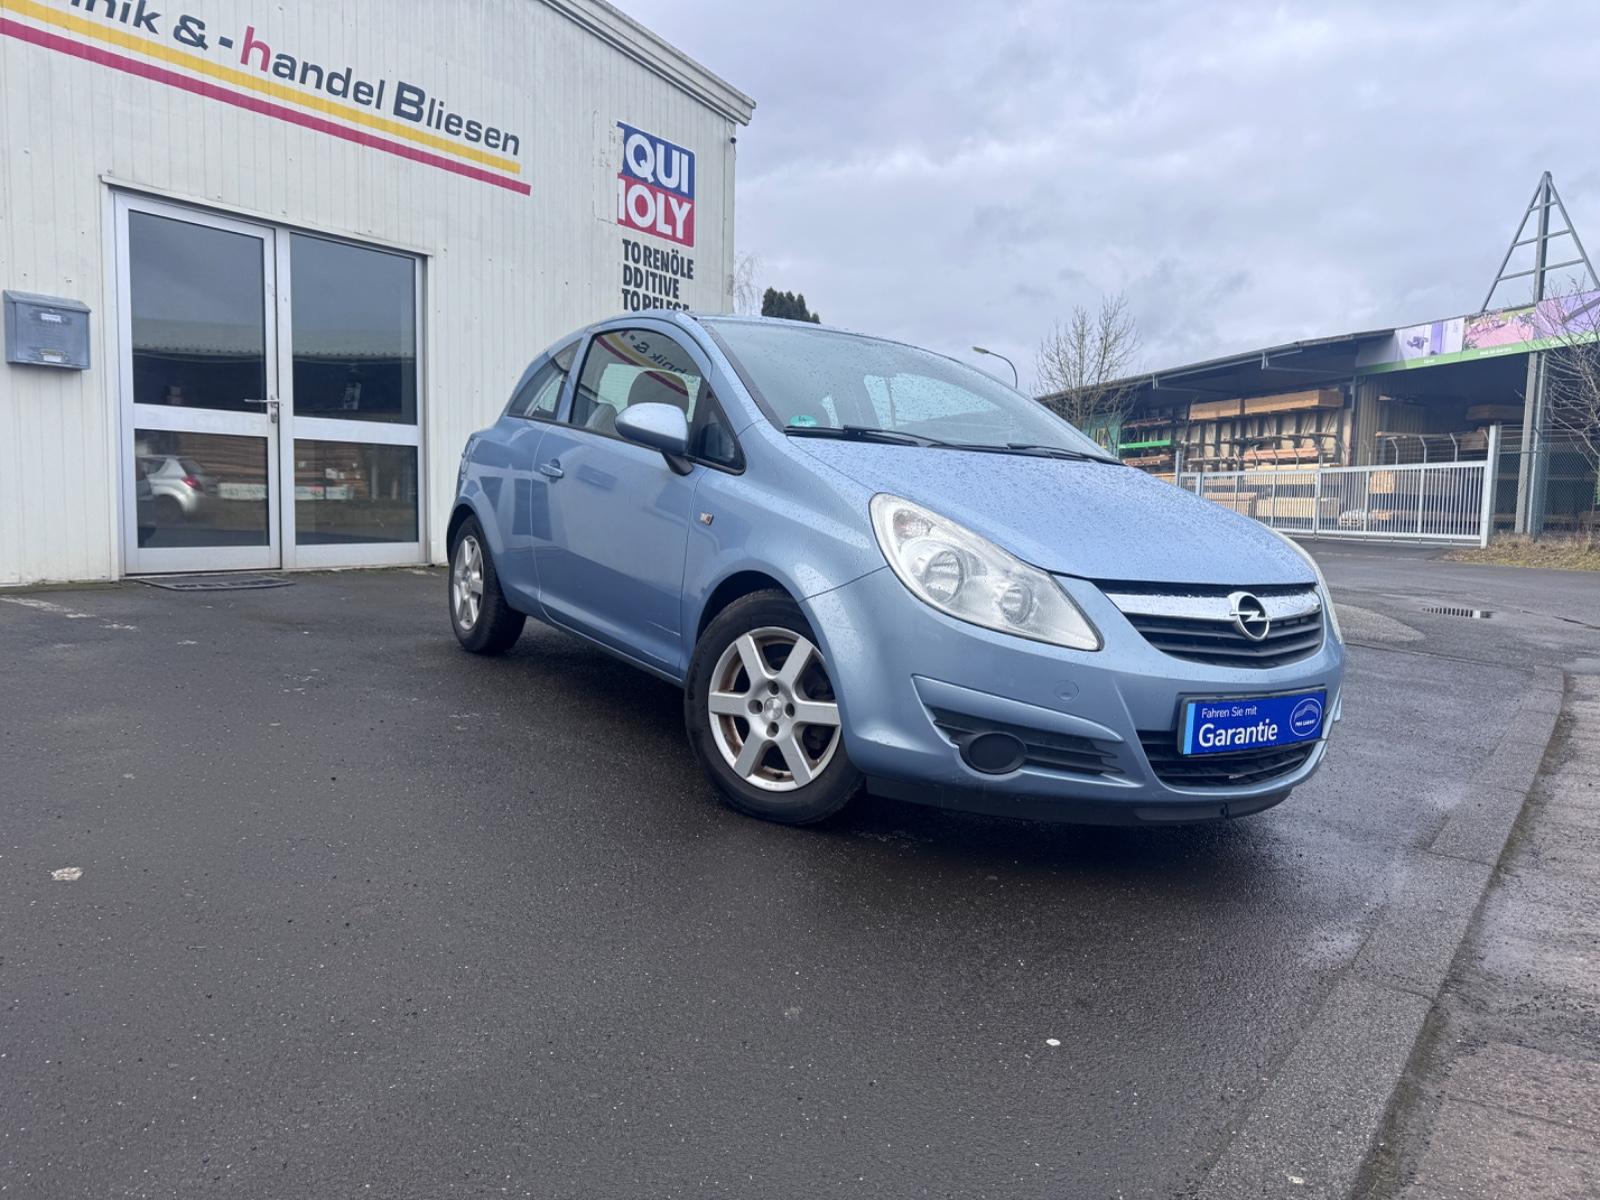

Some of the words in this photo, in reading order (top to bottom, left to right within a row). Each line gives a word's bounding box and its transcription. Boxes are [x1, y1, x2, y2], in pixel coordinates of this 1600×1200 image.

[71, 0, 161, 35] nik
[173, 14, 209, 50] &
[393, 81, 521, 156] Bliesen
[1201, 707, 1230, 718] Fahren
[1231, 706, 1244, 717] Sie
[1245, 705, 1257, 716] mit
[1199, 718, 1278, 747] Garantie
